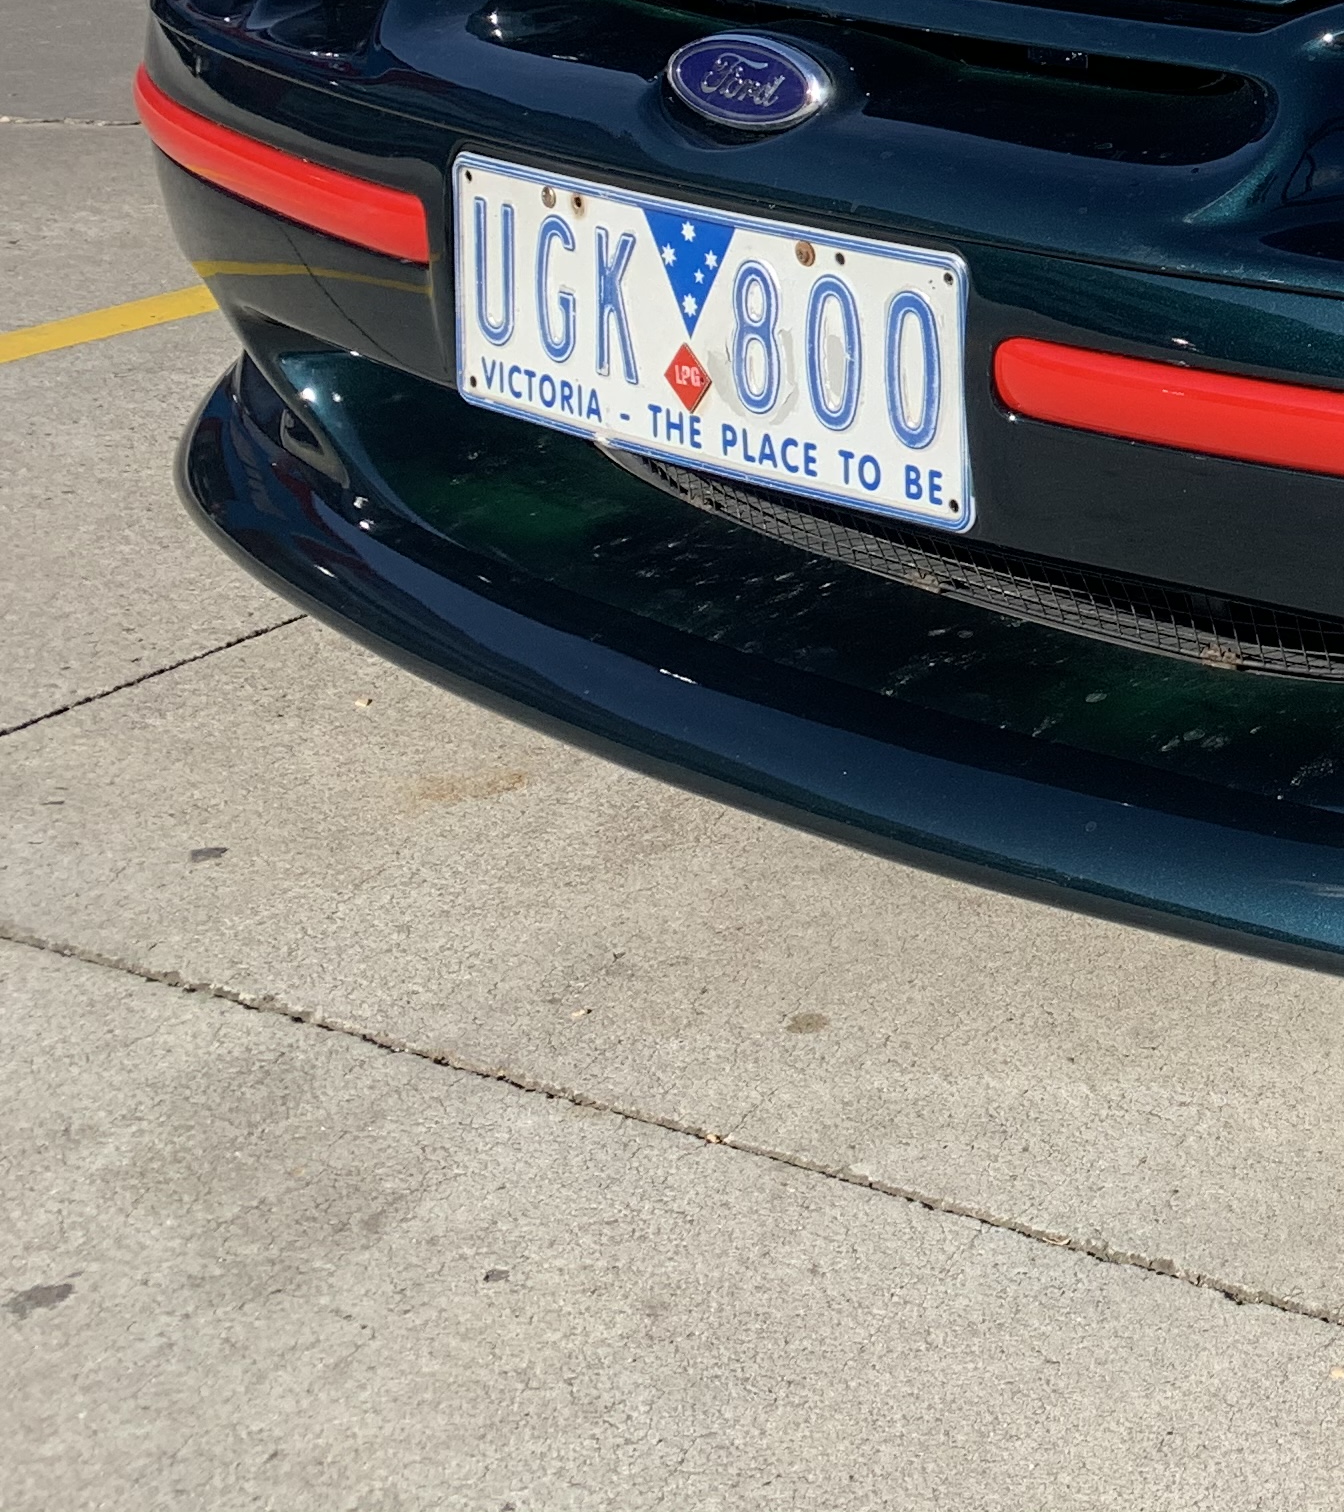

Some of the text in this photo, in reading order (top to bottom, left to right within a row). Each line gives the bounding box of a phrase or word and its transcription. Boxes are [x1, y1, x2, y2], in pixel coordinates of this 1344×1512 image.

[701, 52, 785, 107] Ford
[473, 195, 943, 451] UGK 800
[674, 364, 702, 388] LPG
[480, 355, 602, 424] VICTORIA
[646, 403, 703, 450] THE
[720, 422, 819, 479] PLACE
[837, 449, 882, 492] TO
[904, 464, 944, 507] BE
